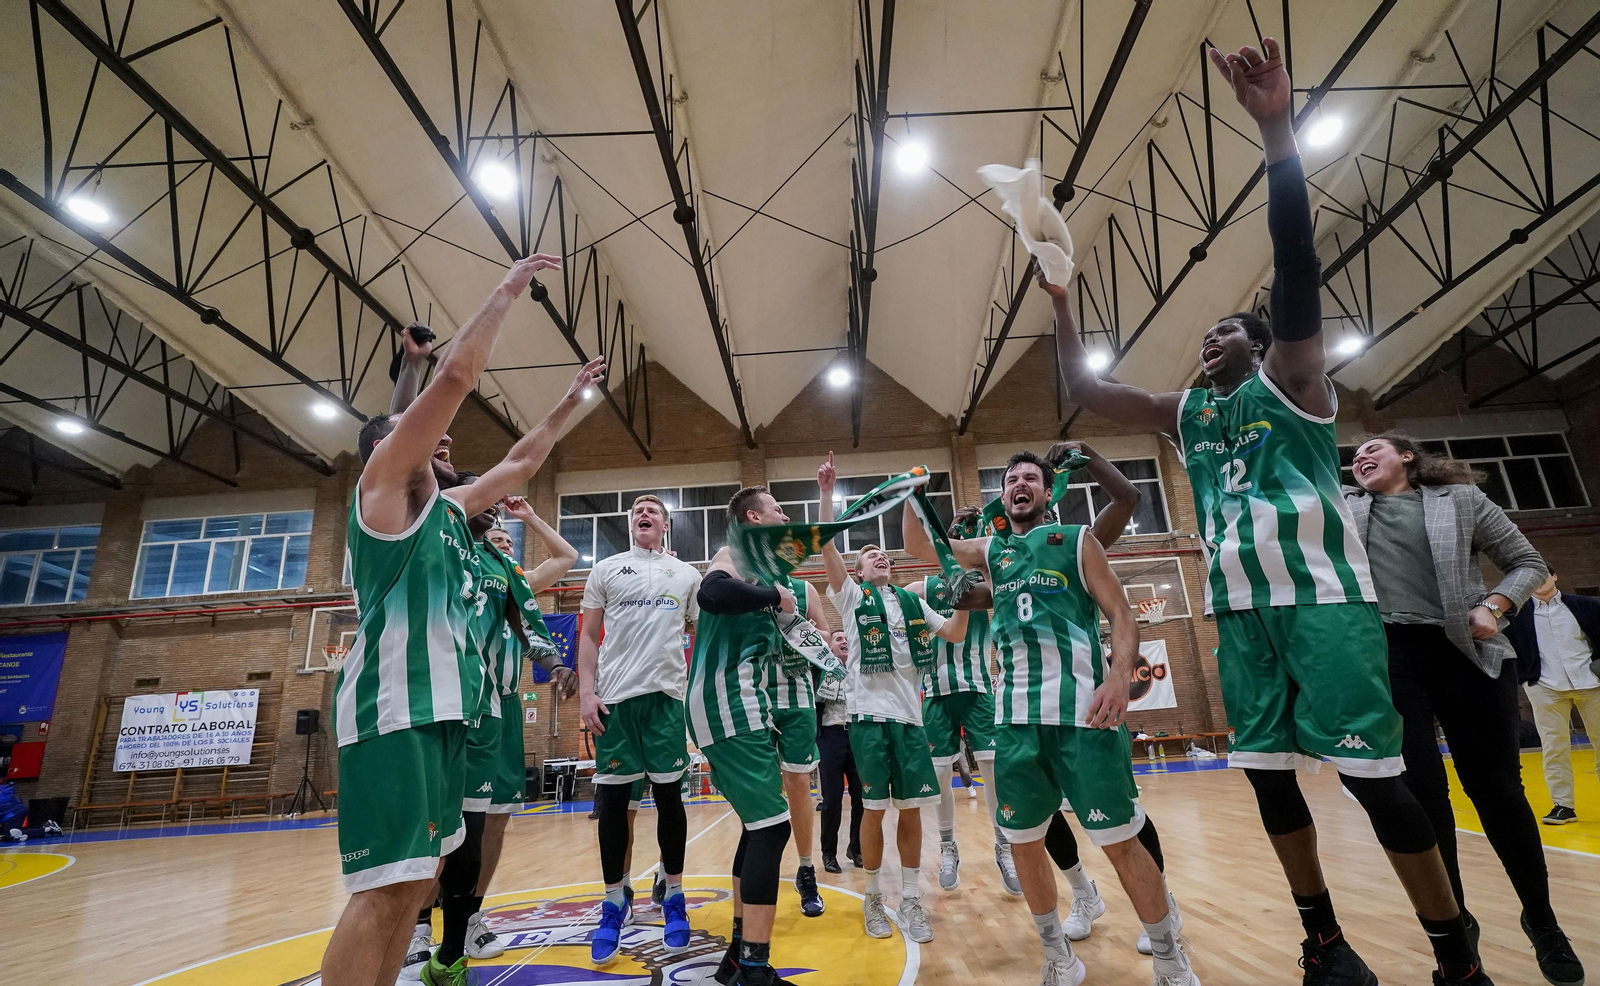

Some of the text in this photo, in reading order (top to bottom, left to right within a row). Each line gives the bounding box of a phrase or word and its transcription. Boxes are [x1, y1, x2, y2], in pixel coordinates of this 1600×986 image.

[1220, 459, 1252, 493] 12
[483, 579, 507, 593] plus
[1029, 574, 1058, 587] plus
[620, 598, 675, 607] energía plus
[1016, 593, 1033, 622] 8
[133, 700, 254, 715] Young YS Solutions
[120, 720, 253, 736] CONTRATO LABORAL
[138, 734, 191, 742] TRABAJADORES
[230, 729, 252, 737] AÑOS
[163, 740, 180, 748] 100%
[181, 739, 192, 747] DE
[118, 762, 136, 771] 674
[138, 761, 150, 769] 31
[152, 760, 163, 768] 08
[164, 759, 175, 768] 05
[183, 758, 194, 767] 91
[198, 757, 214, 765] 186
[227, 755, 241, 764] 79
[341, 848, 370, 863] appa
